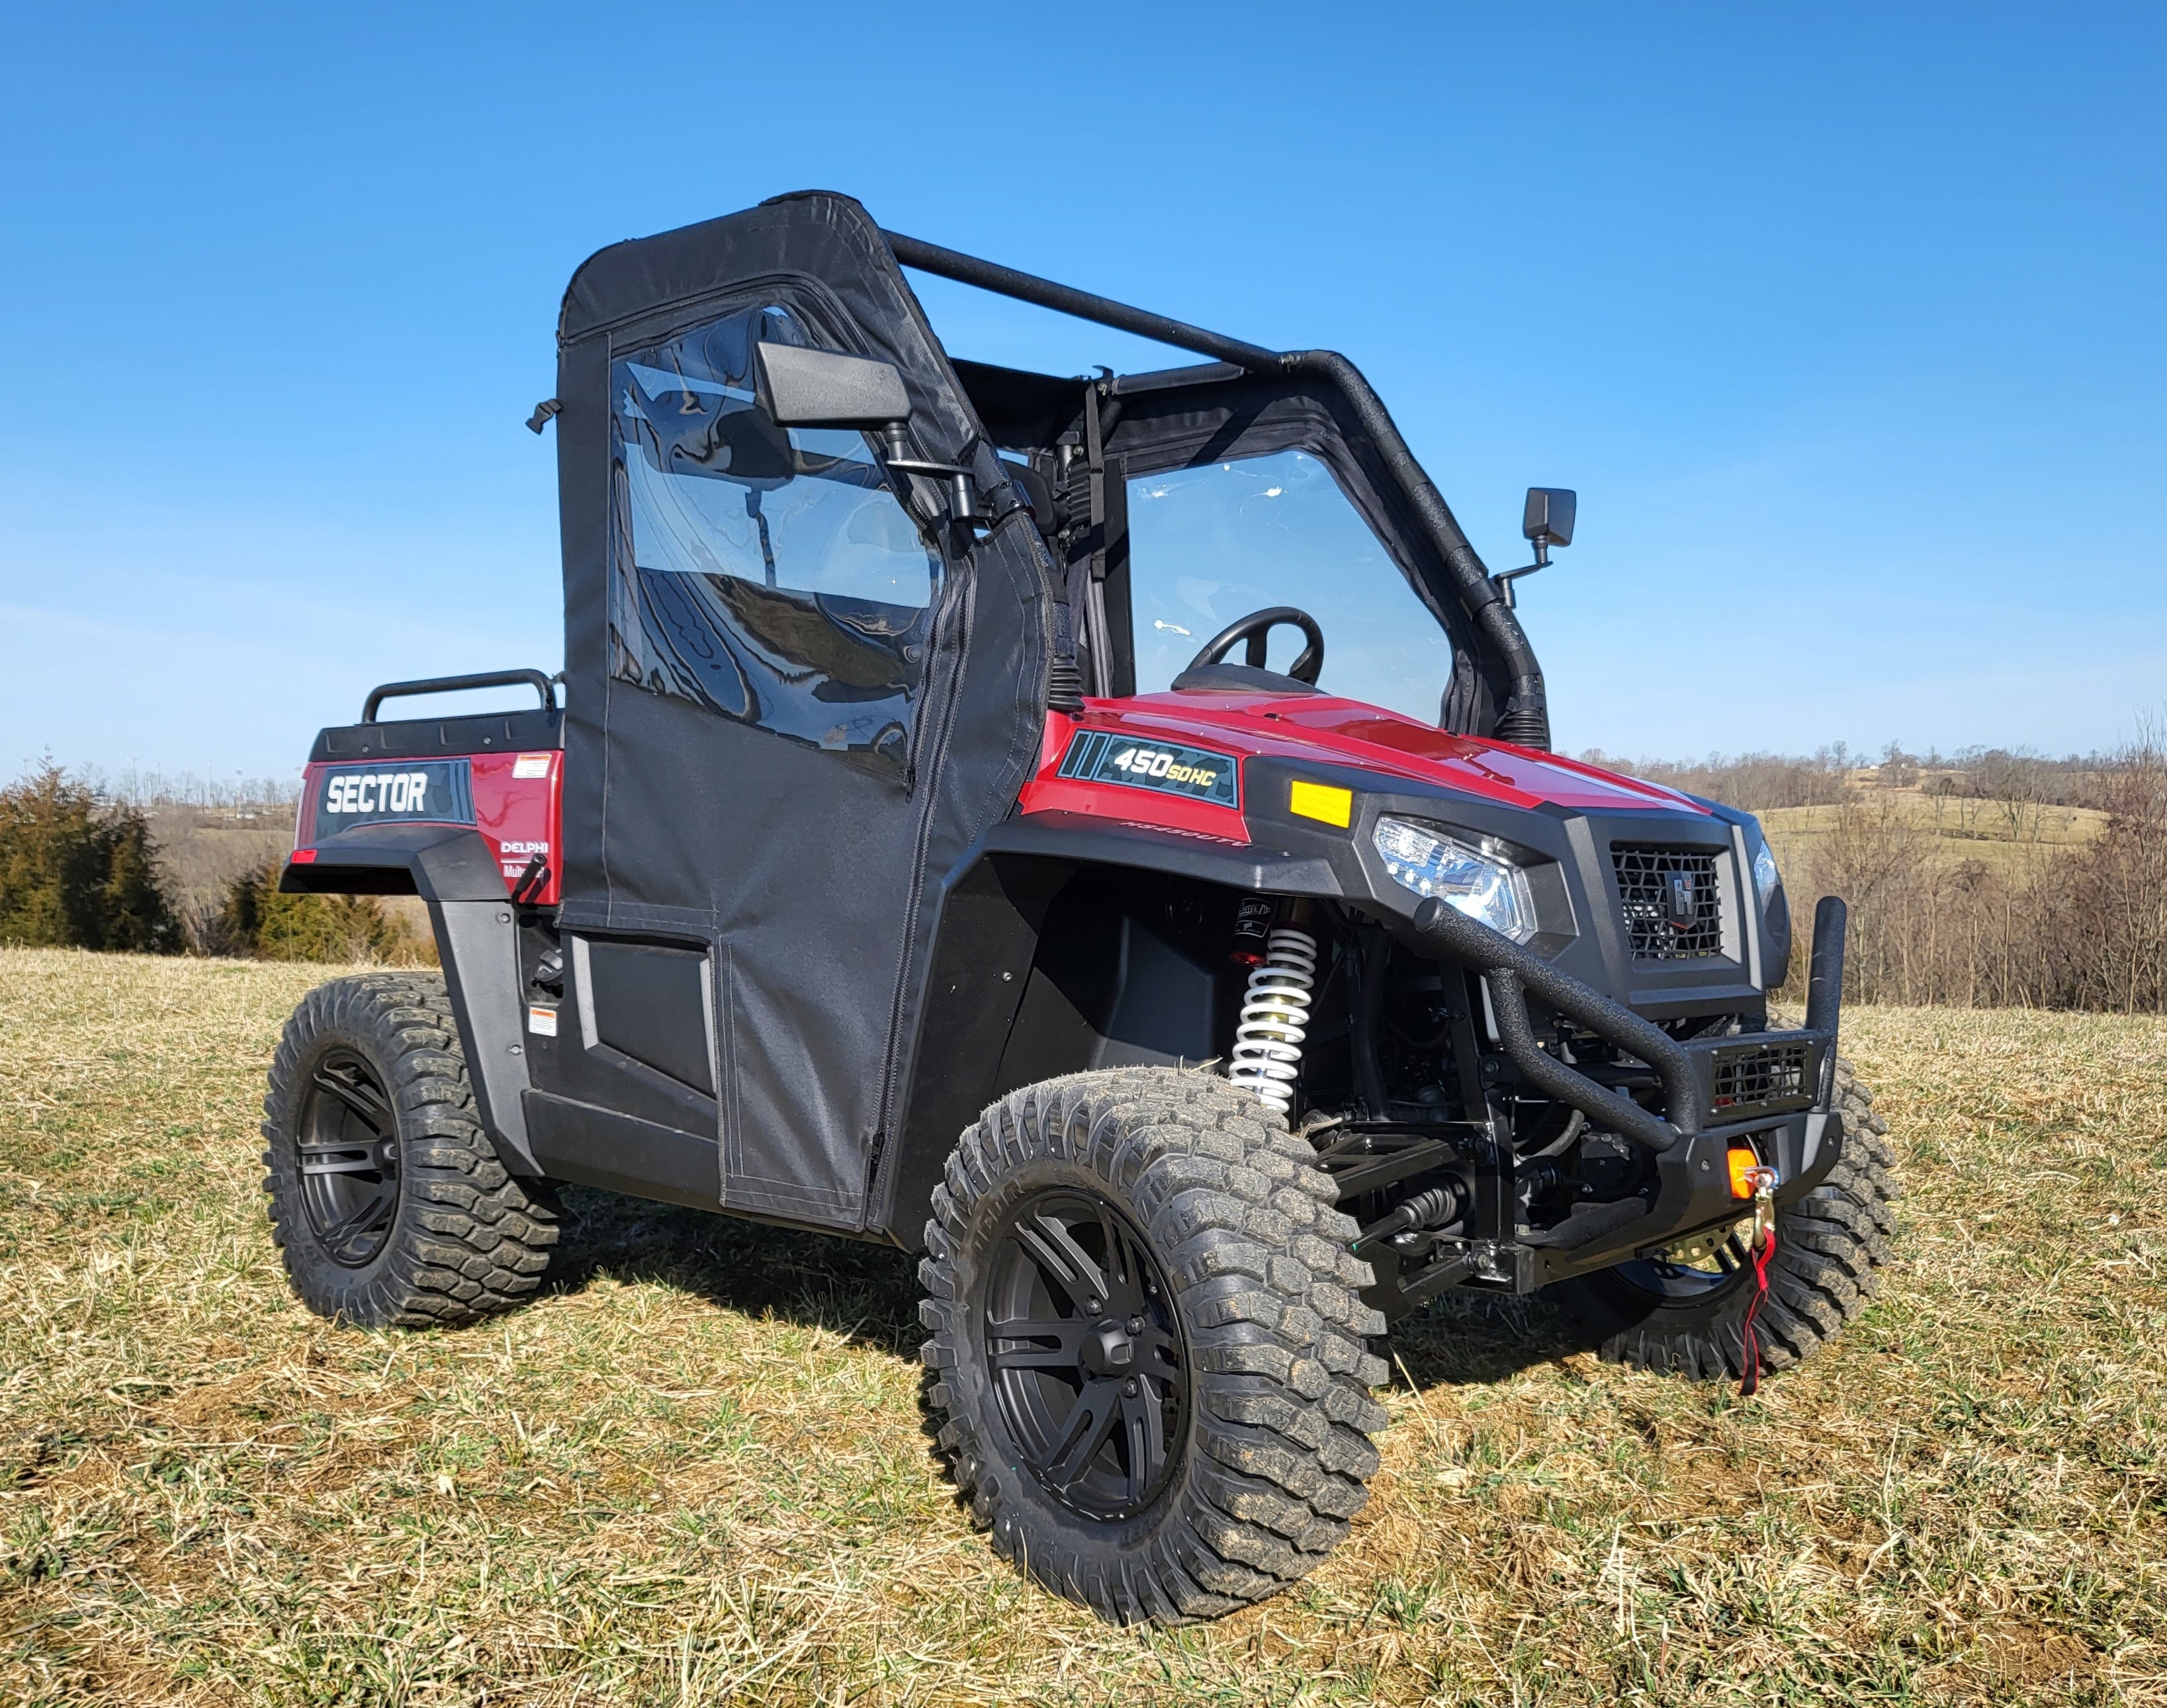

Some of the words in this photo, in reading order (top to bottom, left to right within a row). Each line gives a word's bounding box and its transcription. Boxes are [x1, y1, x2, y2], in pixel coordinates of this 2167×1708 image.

[1114, 748, 1174, 777] 450
[1166, 765, 1217, 787] SOHC
[327, 773, 428, 813] SECTOR
[500, 841, 549, 853] DELPHI
